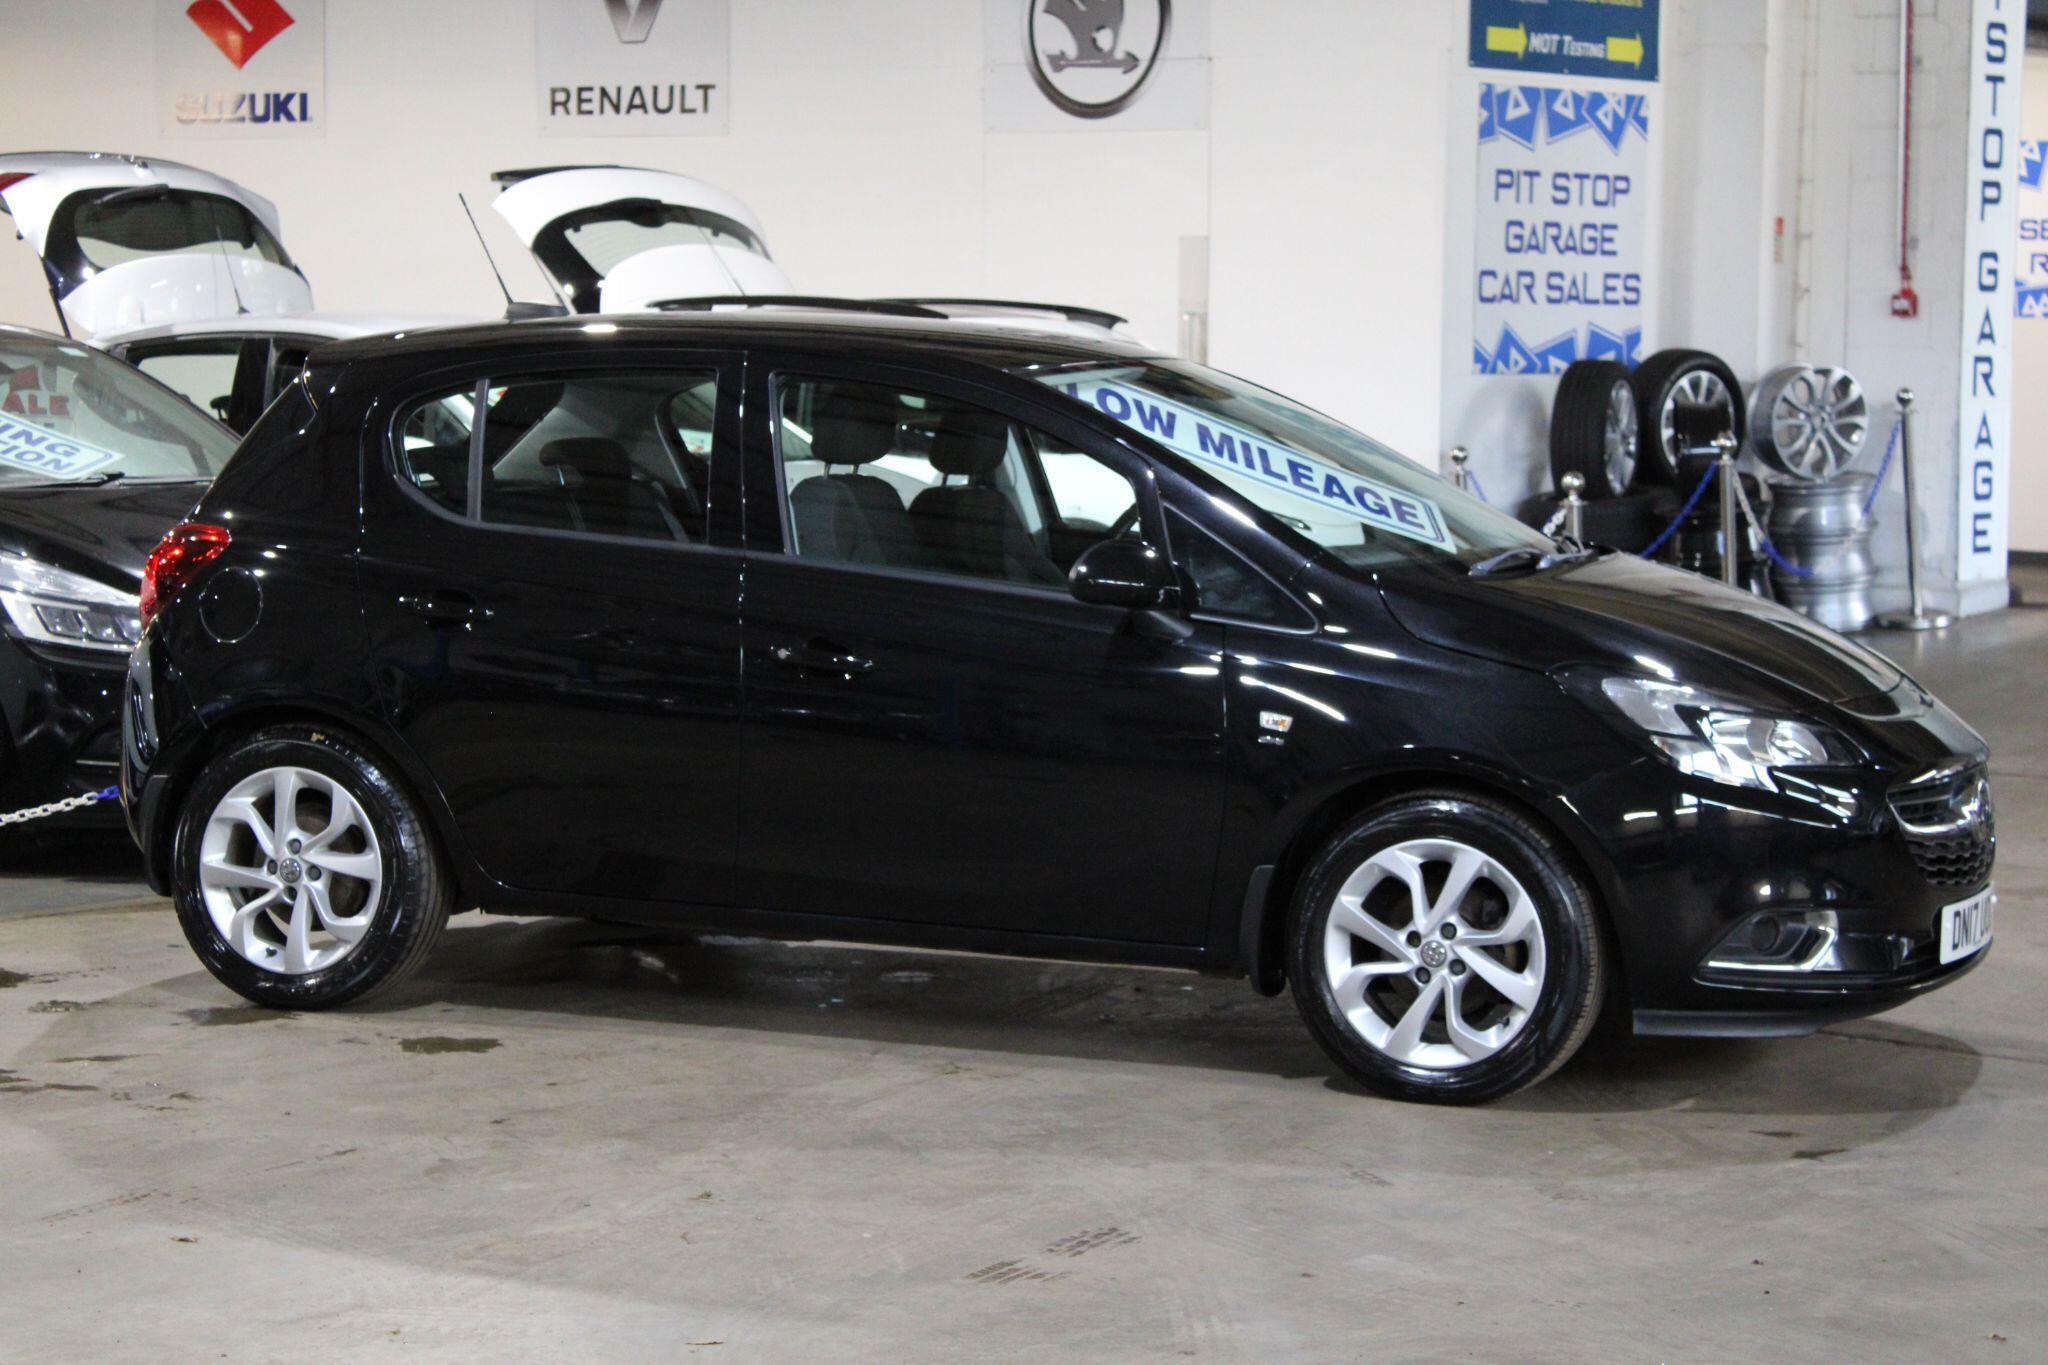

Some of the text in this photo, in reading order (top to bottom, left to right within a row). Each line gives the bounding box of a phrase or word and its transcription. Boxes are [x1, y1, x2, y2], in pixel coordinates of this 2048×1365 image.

[175, 93, 308, 123] SUZUKI
[550, 84, 716, 116] RENAULT
[1494, 168, 1631, 207] PIT STOP
[1504, 220, 1619, 256] GARAGE
[1478, 270, 1641, 305] CAR SALES
[1972, 22, 2007, 553] STOP GARAGE
[0, 440, 74, 471] ION
[1066, 382, 1425, 529] LOW MILEAGE
